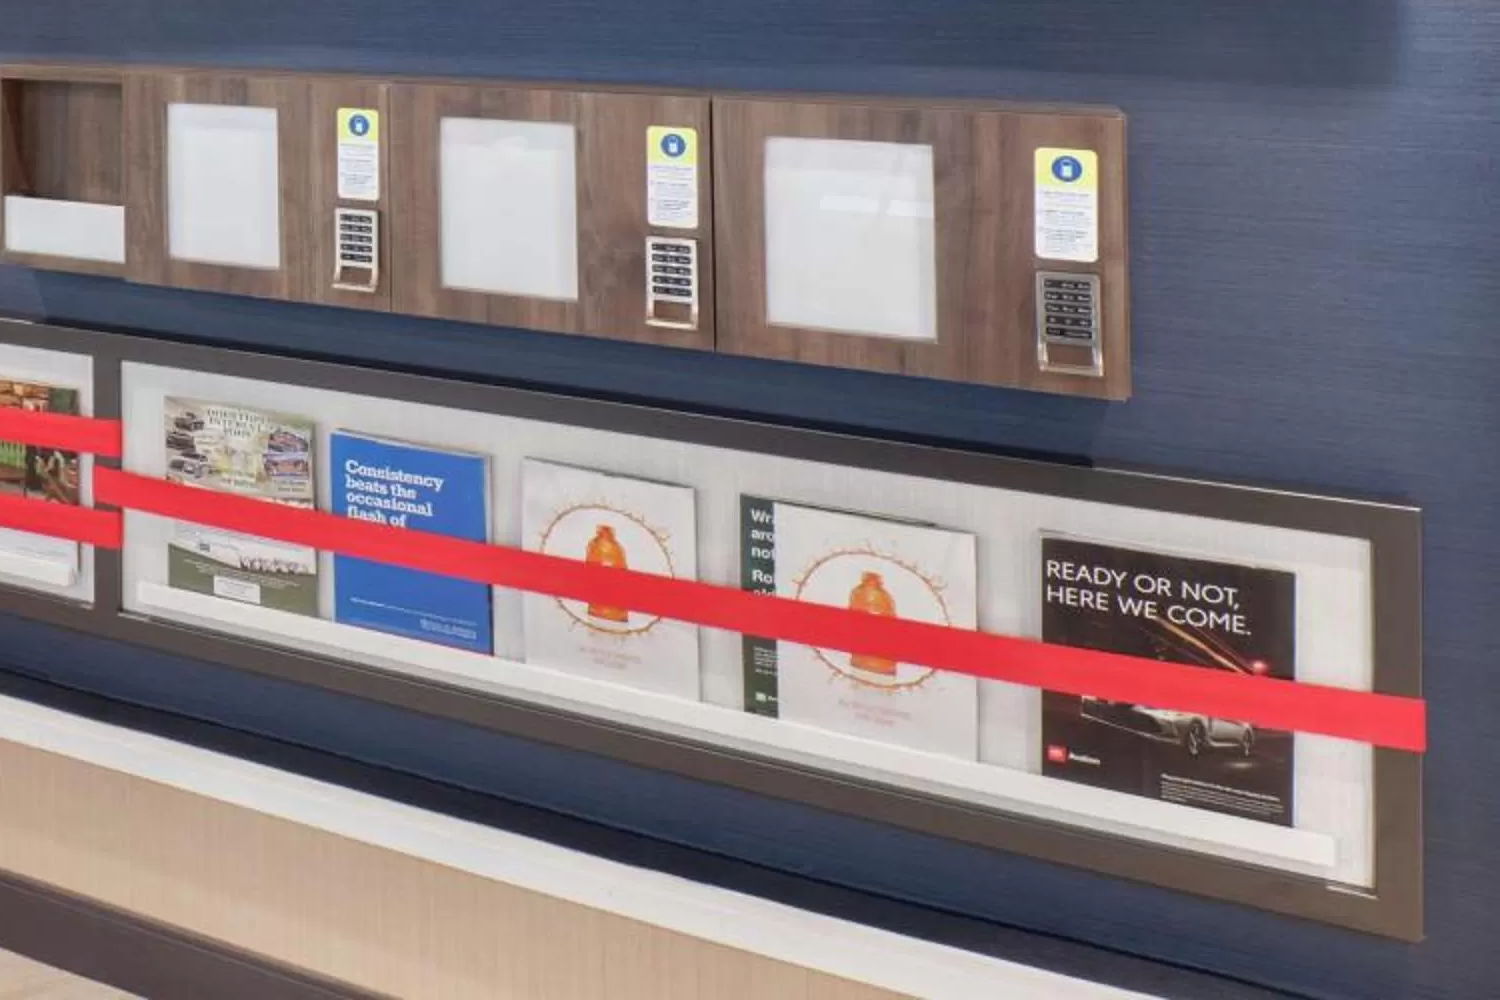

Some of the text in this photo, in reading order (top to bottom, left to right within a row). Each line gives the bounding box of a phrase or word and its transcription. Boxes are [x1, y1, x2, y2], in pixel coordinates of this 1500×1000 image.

[345, 460, 444, 491] Consistency
[345, 474, 417, 500] beats the
[346, 492, 433, 517] occasional
[347, 506, 407, 528] flash of
[1046, 559, 1239, 611] READY OR NOT,
[1046, 585, 1252, 635] HERE WE COME.
